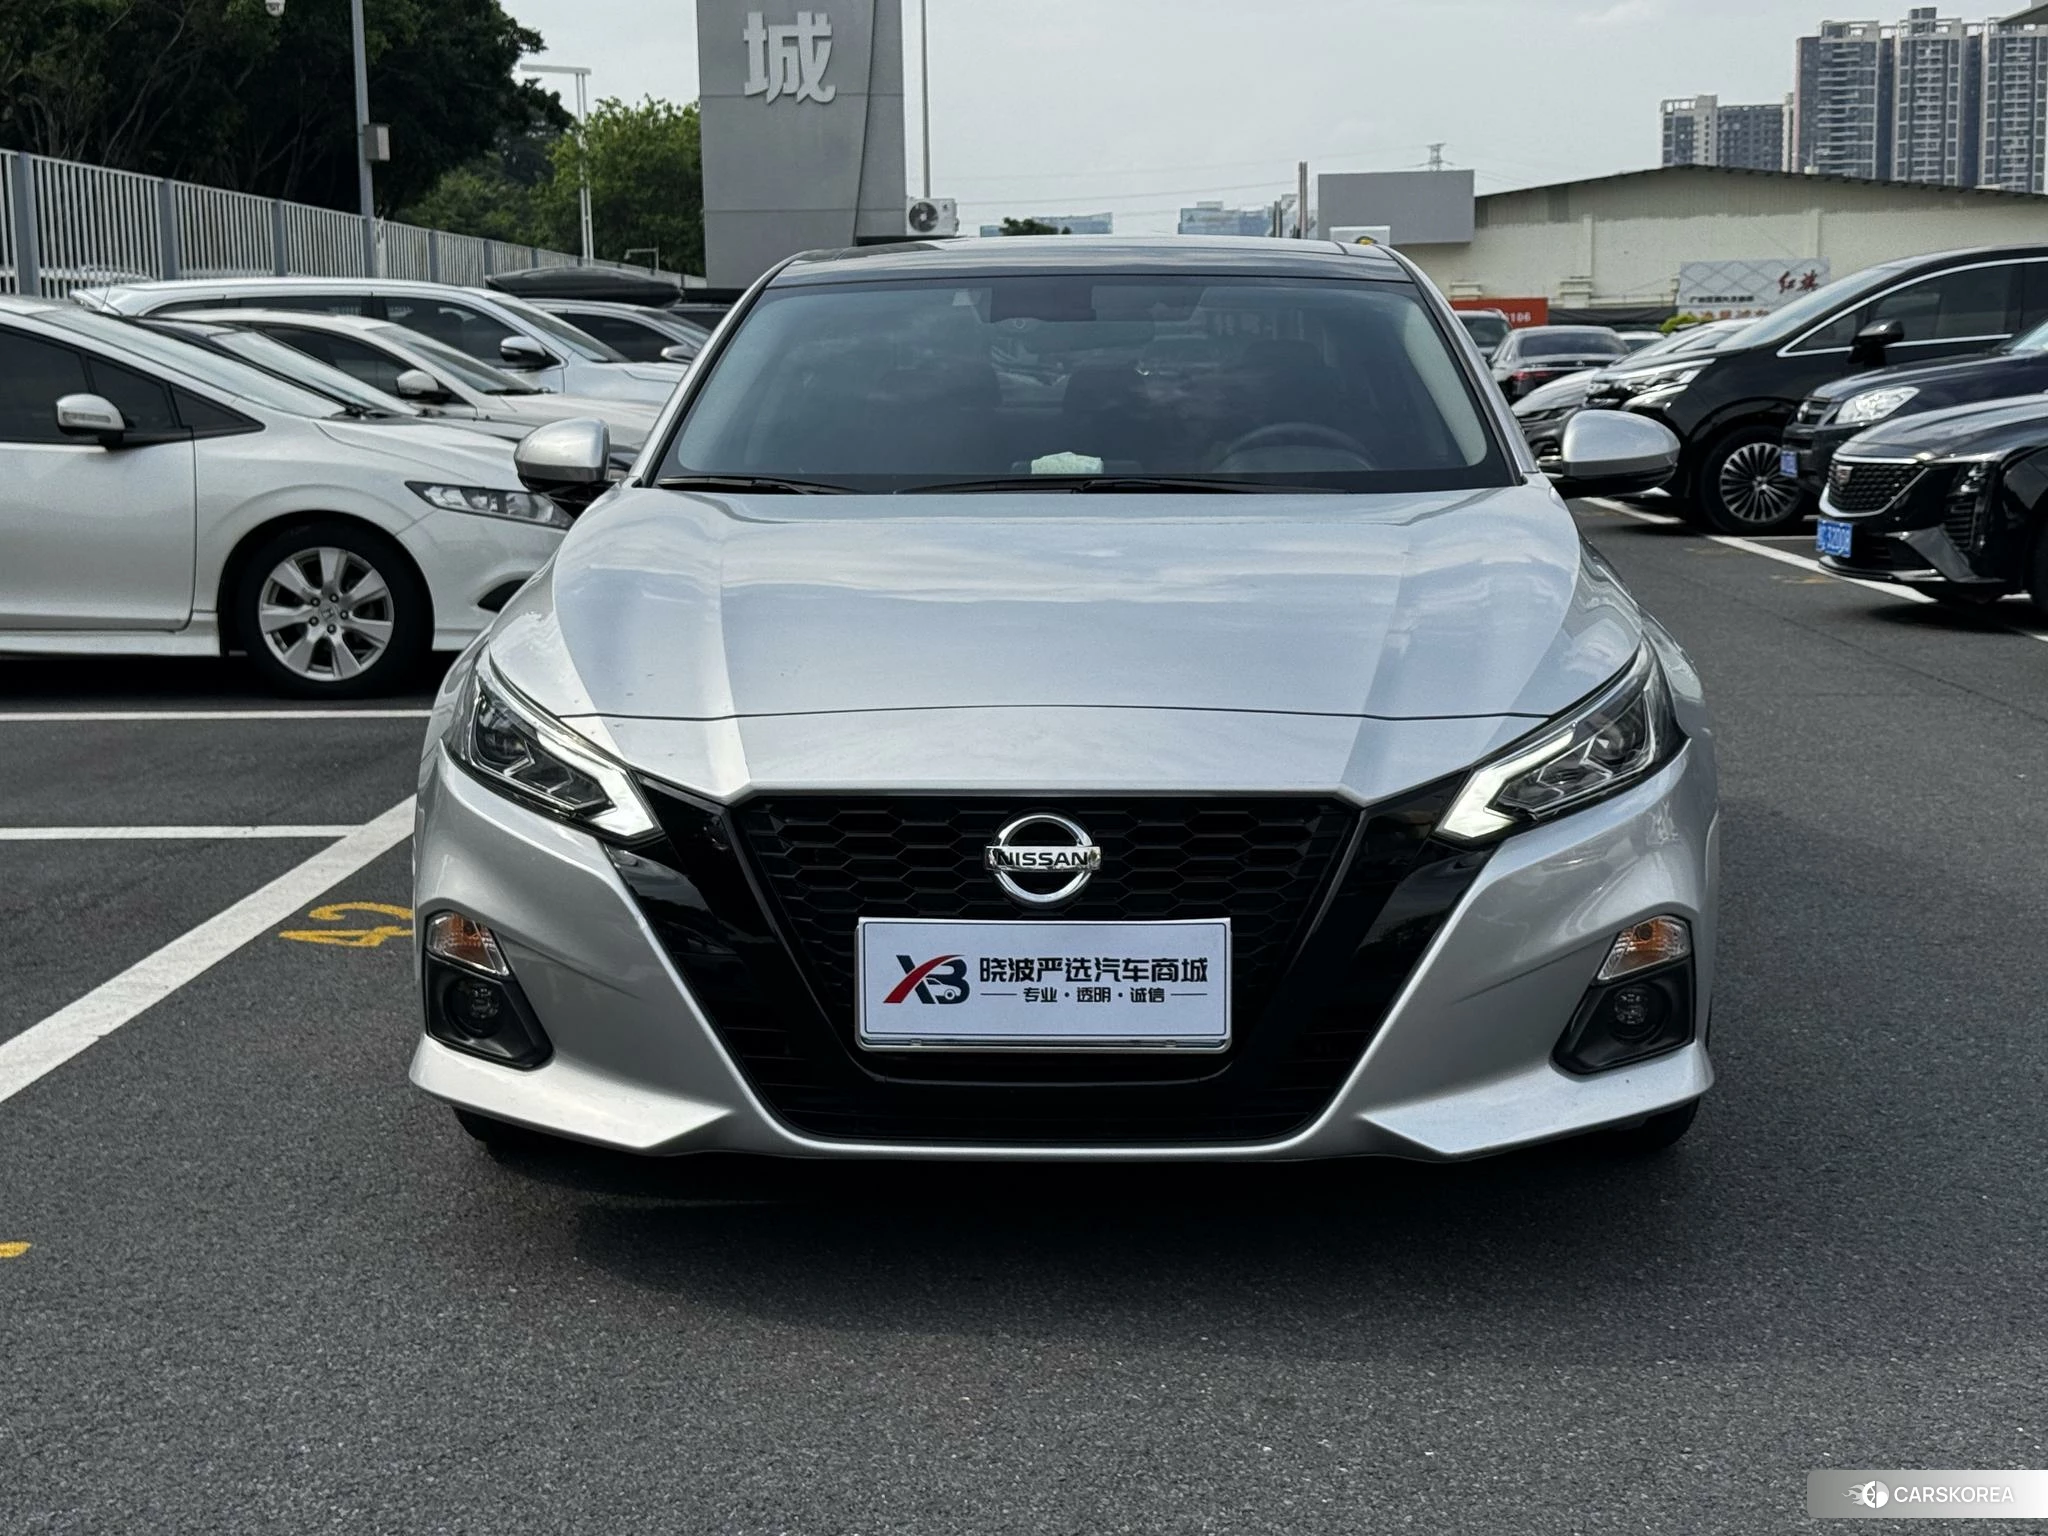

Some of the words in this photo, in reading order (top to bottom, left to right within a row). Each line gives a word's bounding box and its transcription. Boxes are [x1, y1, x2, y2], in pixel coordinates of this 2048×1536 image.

[743, 11, 836, 105] 城
[995, 850, 1090, 868] NISSAN
[979, 956, 1208, 984] 晓波严选汽车商城
